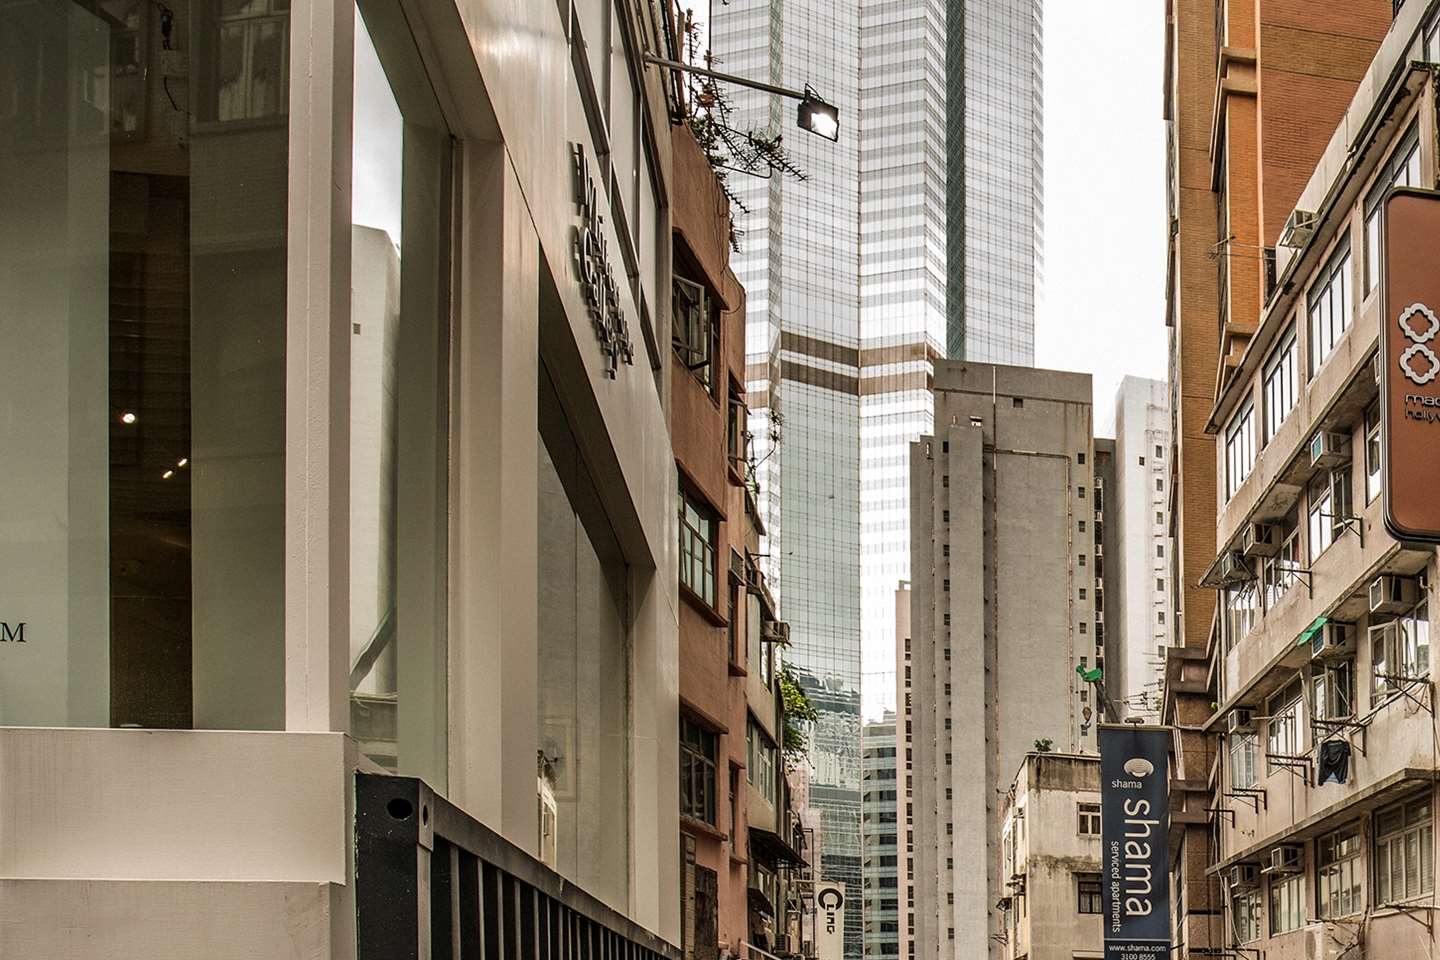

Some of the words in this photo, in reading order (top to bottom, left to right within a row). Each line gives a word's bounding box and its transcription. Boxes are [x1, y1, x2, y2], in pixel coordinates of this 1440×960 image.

[1111, 779, 1143, 789] shama
[1111, 840, 1120, 879] serviced
[1124, 798, 1159, 916] shama
[1111, 880, 1122, 933] apartments
[1109, 944, 1167, 953] www.shama.com
